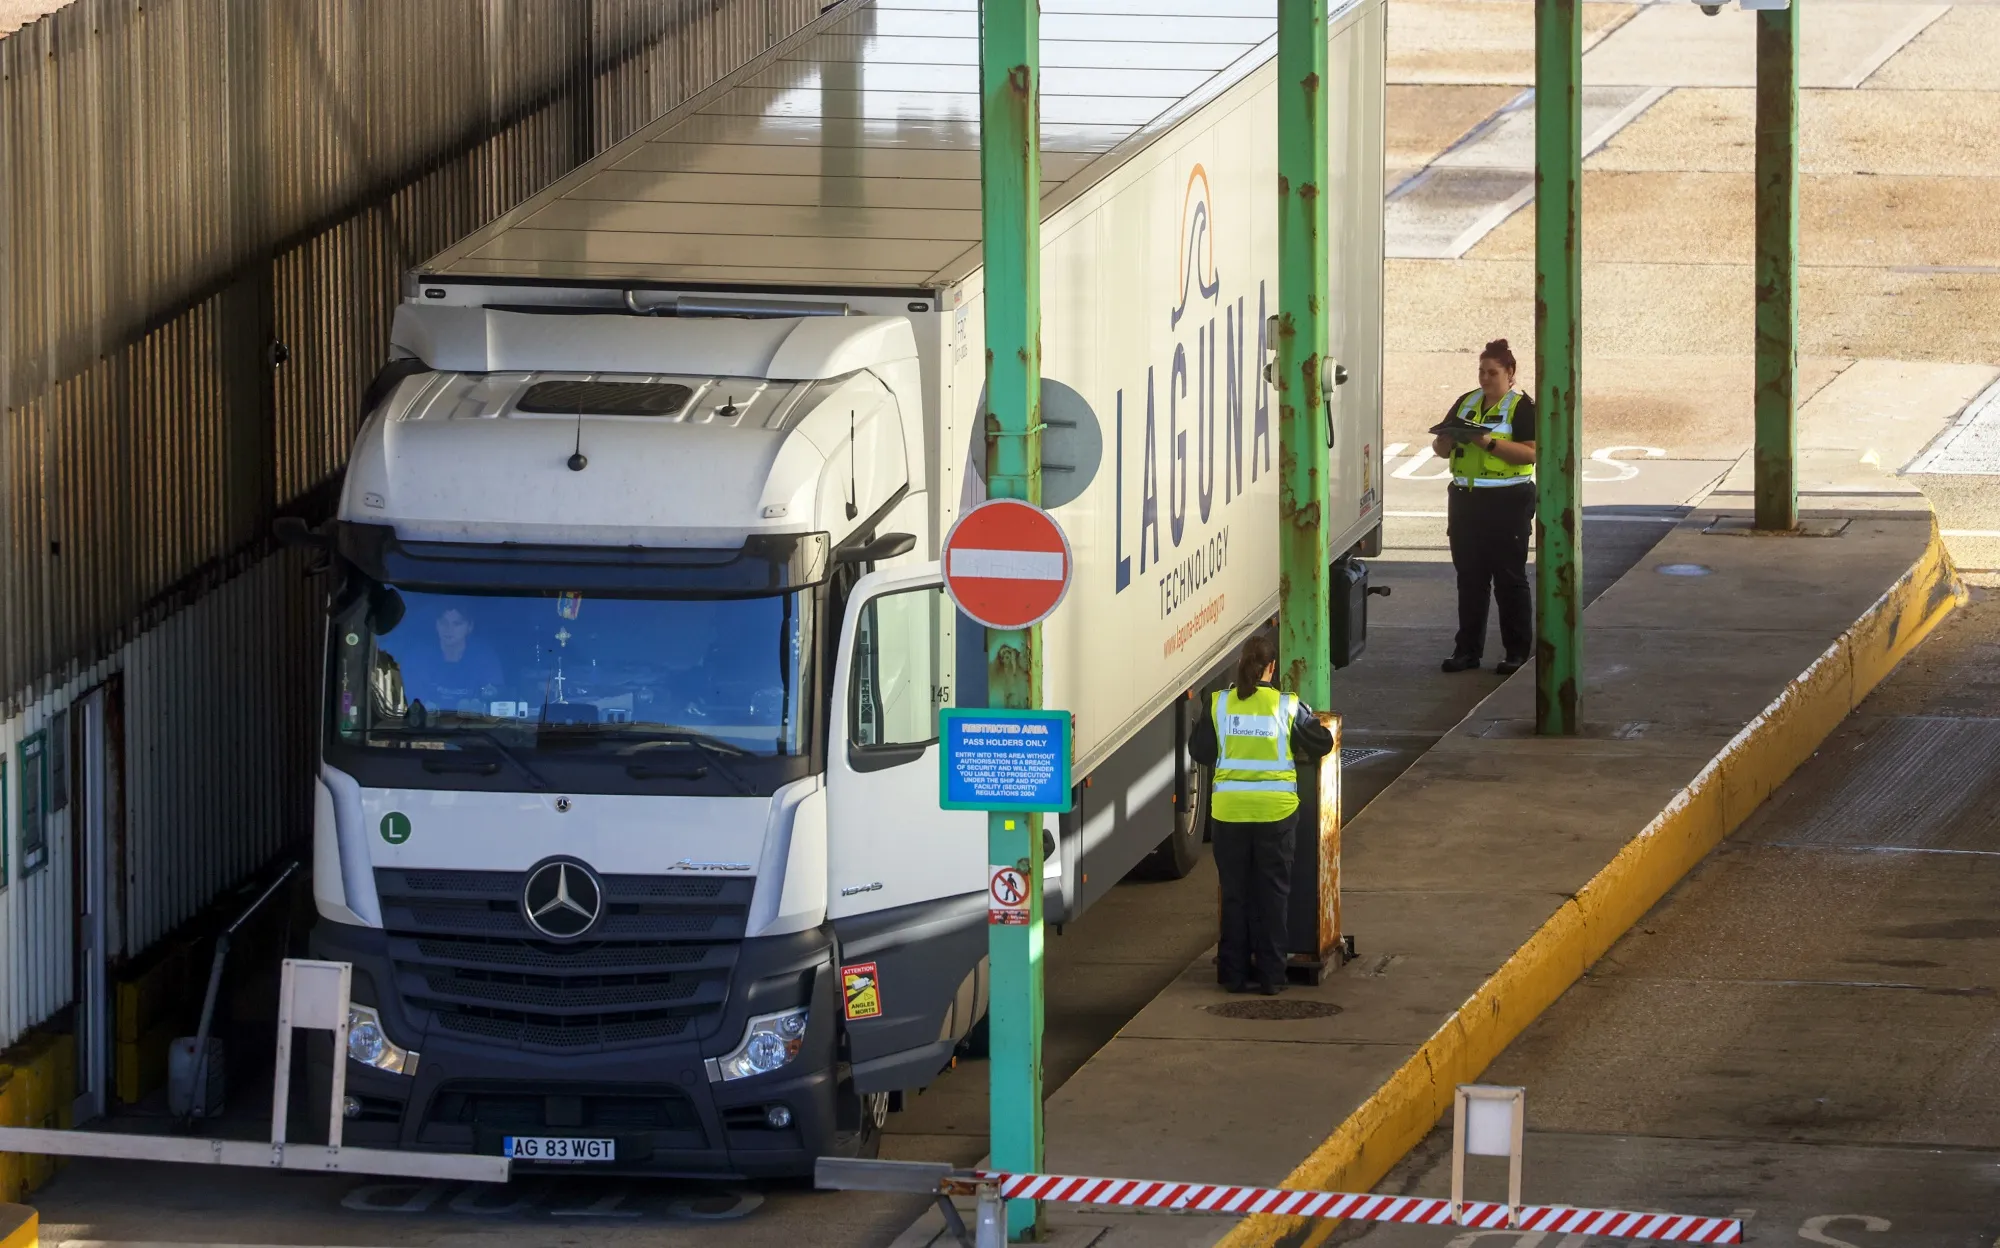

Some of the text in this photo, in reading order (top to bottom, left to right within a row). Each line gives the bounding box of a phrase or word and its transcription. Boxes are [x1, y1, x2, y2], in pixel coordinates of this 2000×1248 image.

[1116, 279, 1271, 595] LAGUNA
[1160, 525, 1229, 620] TECHNOLOGY
[962, 723, 1049, 734] RESTRICTED AREA
[1232, 728, 1254, 736] Border
[963, 738, 984, 746] PASS
[985, 739, 1024, 747] HOLDERS
[389, 818, 402, 838] L
[843, 965, 874, 975] ATTENTION
[851, 1001, 875, 1009] ANGLES
[855, 1007, 876, 1015] MORTS
[514, 1139, 612, 1158] AG 83 WGT
